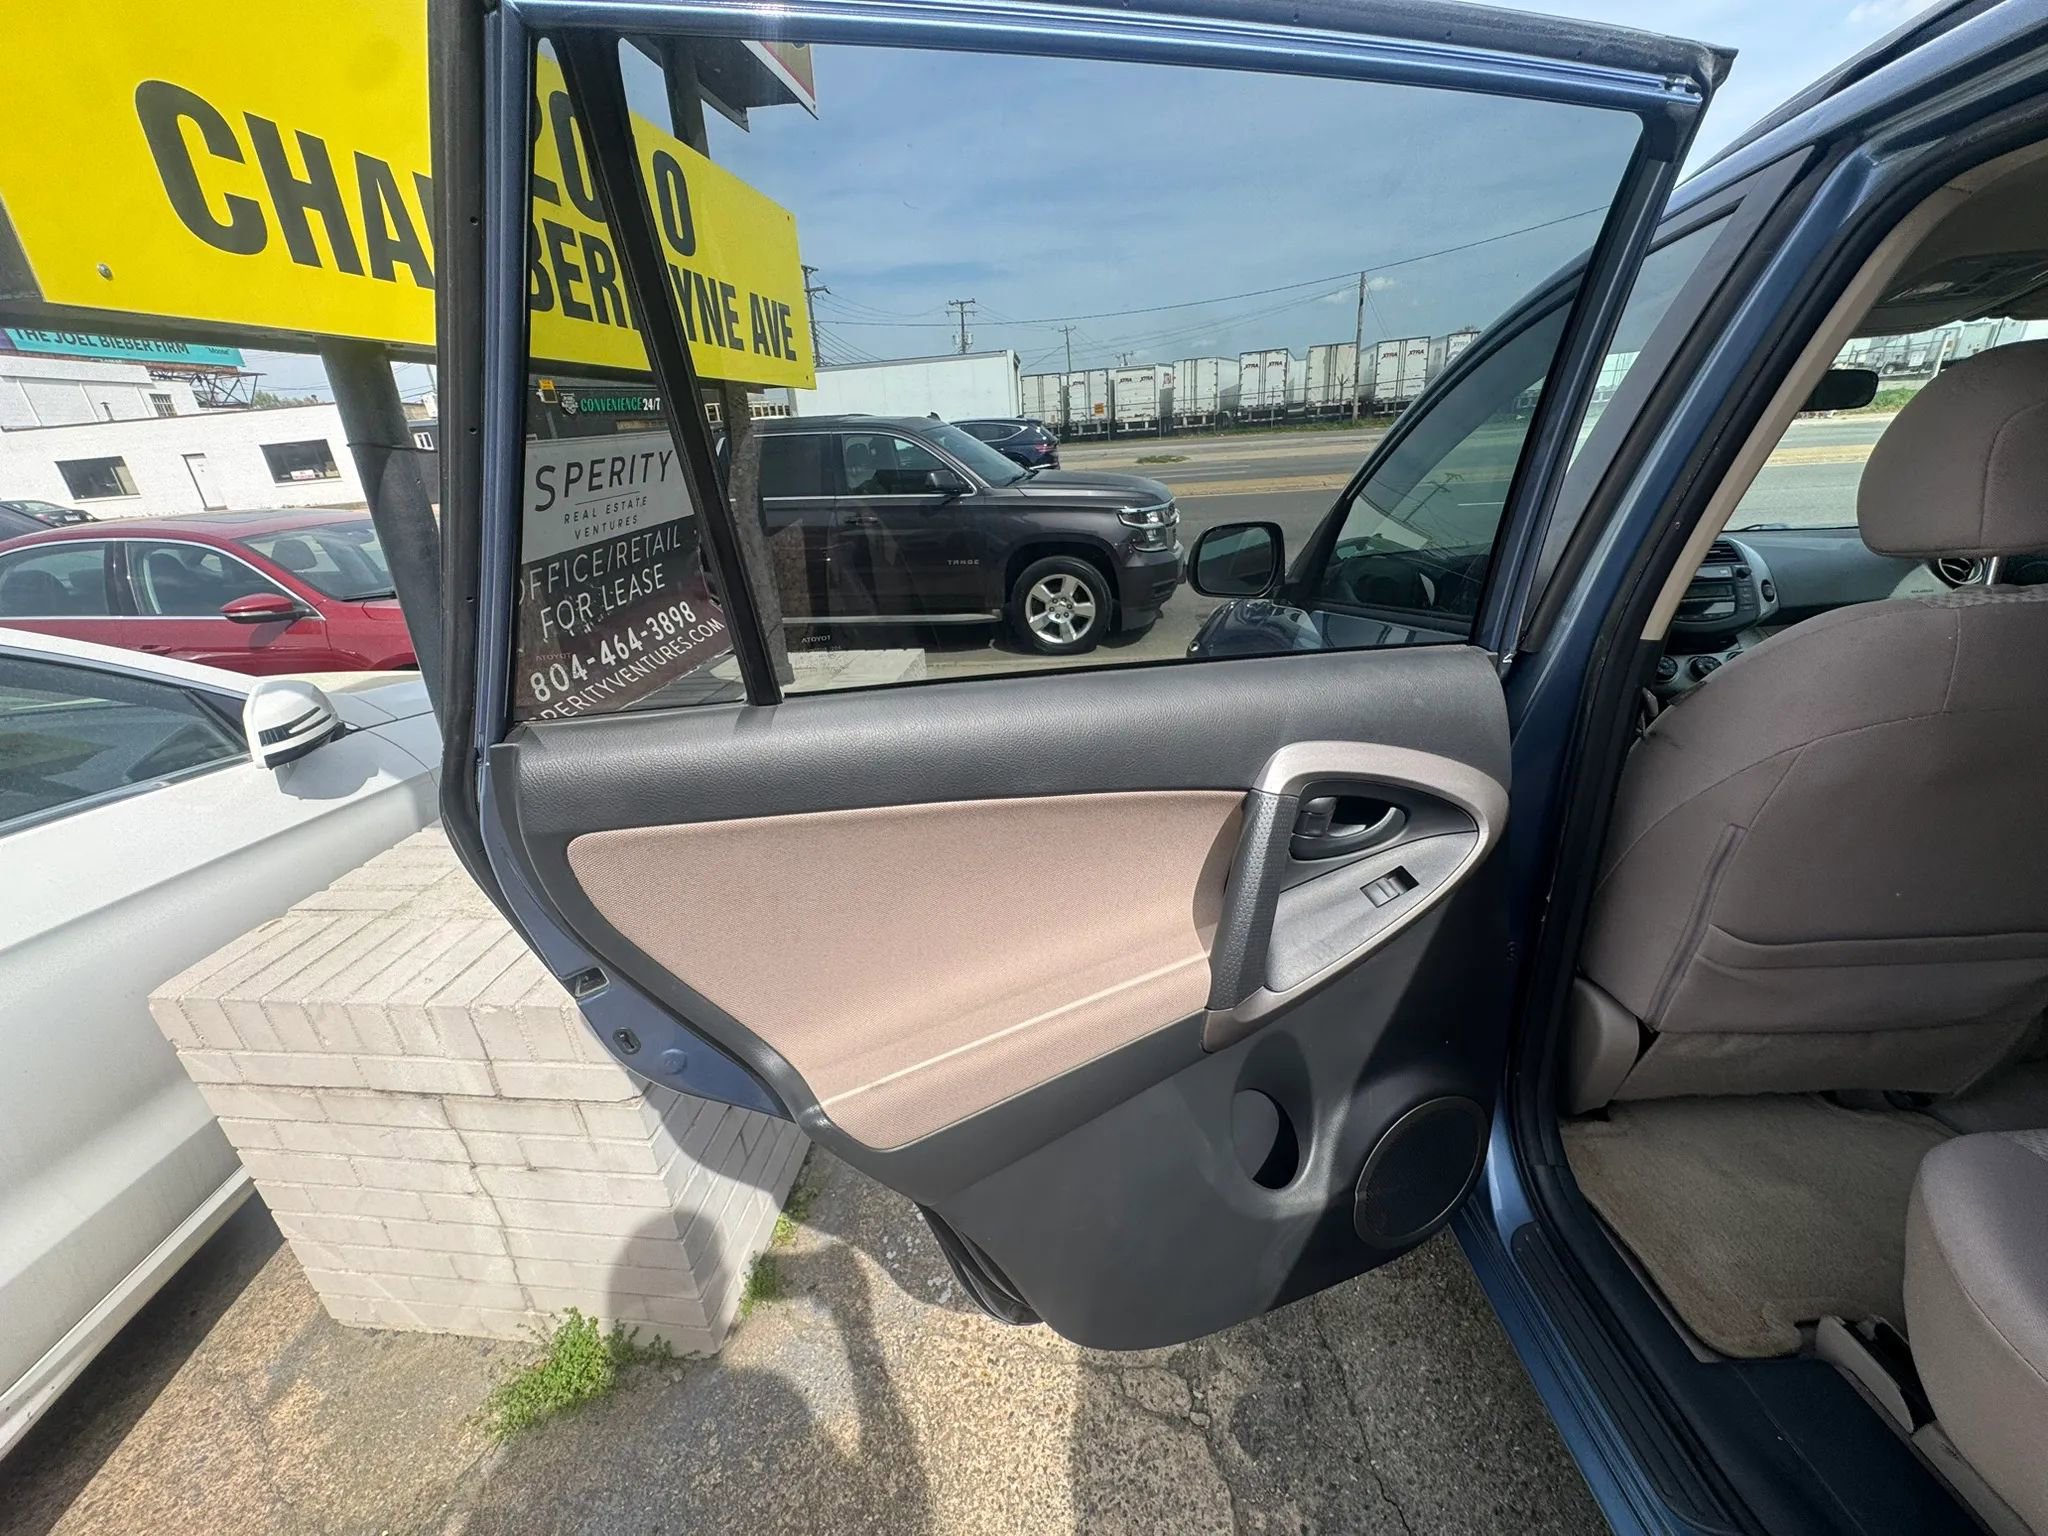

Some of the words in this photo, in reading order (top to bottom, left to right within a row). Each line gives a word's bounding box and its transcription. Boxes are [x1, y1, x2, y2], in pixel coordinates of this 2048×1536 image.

[15, 328, 50, 342] THE
[54, 331, 98, 347] JOEL
[98, 335, 154, 352] BIEBER
[154, 341, 190, 354] FIRM
[749, 292, 797, 362] AVE
[580, 397, 642, 412] CONVENIENCE
[642, 397, 661, 411] 24/7
[534, 450, 673, 512] SPERITY
[564, 508, 597, 524] REAL
[605, 496, 647, 514] ESTATE
[574, 515, 638, 540] VENTURES
[540, 592, 593, 640] FOR
[601, 563, 666, 611] LEASE
[528, 617, 726, 720] ERITYVENTURES.COM
[530, 601, 696, 702] 804-464-3898
